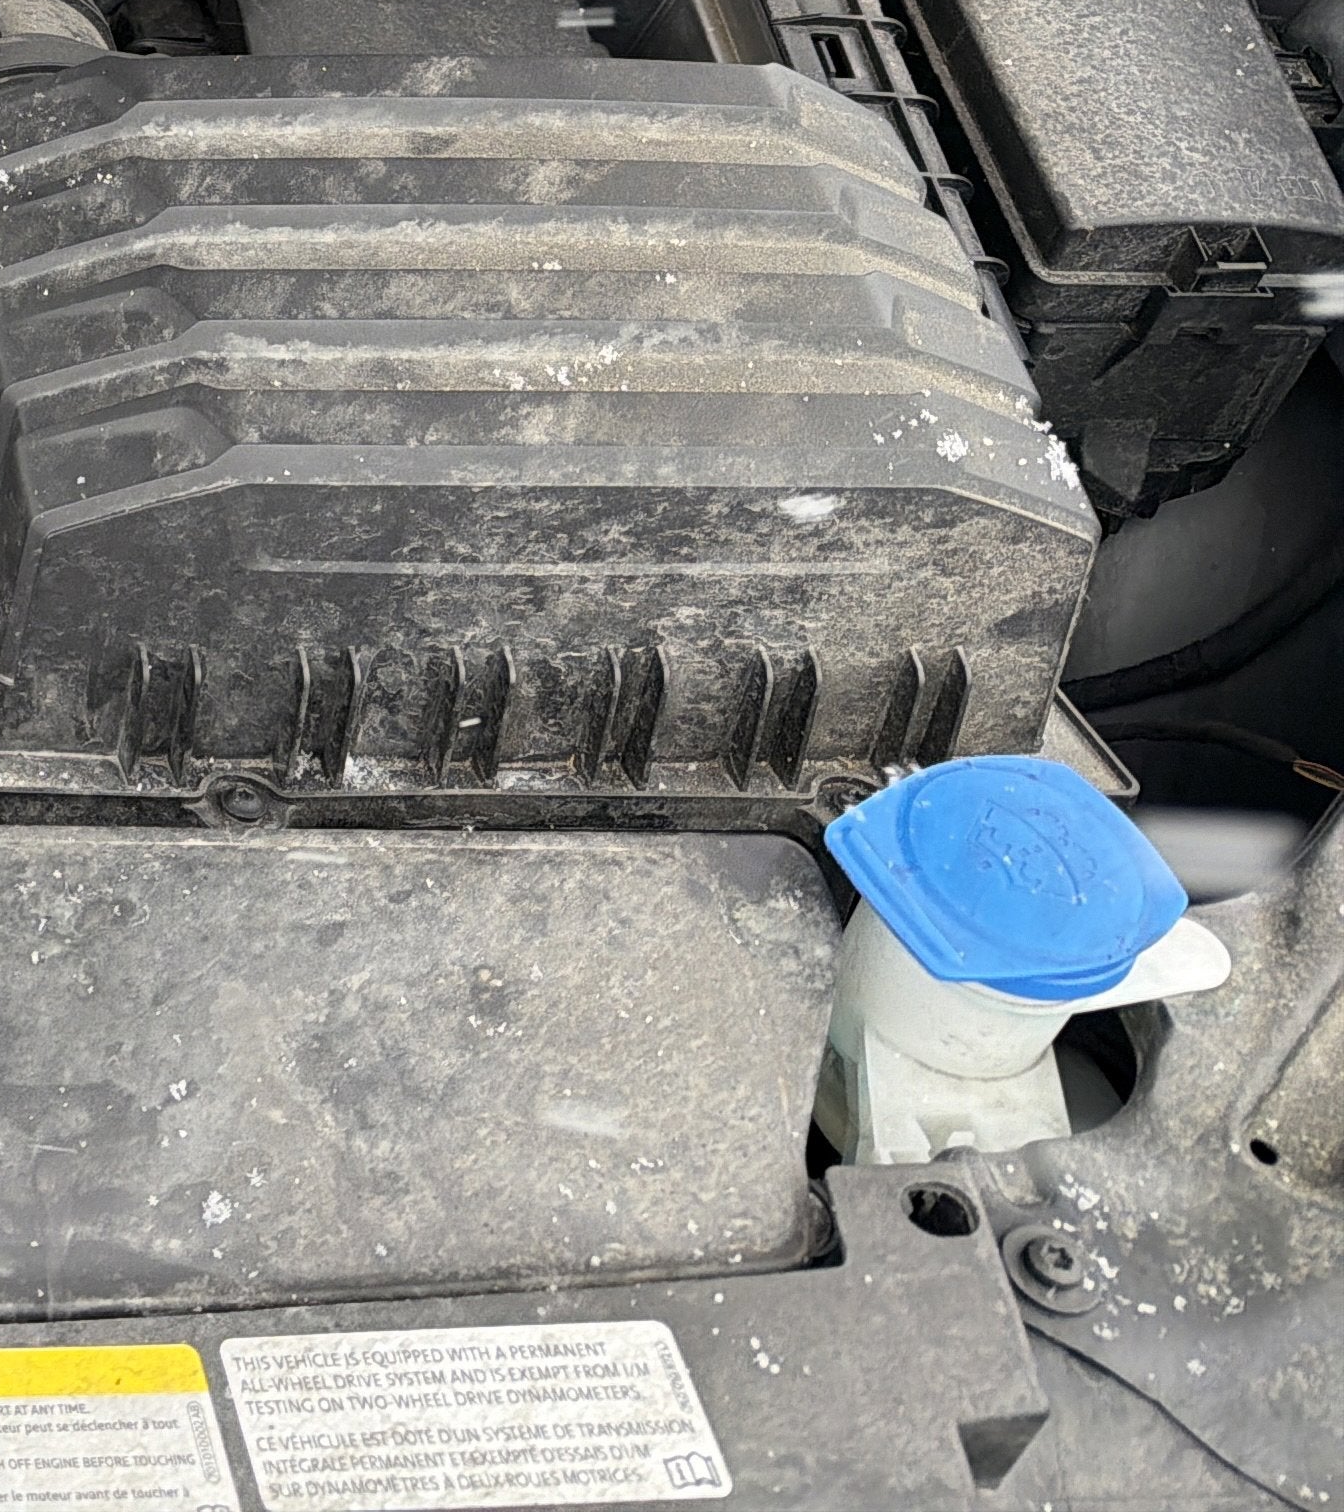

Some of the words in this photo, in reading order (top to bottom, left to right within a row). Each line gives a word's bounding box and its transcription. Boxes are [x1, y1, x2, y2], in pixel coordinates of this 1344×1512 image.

[233, 1355, 271, 1373] THIS
[273, 1352, 342, 1371] VEHICLE
[345, 1351, 361, 1369] IS
[363, 1348, 443, 1368] EQUIPPED
[446, 1346, 490, 1363] WITH
[495, 1346, 507, 1360] A
[512, 1342, 608, 1360] PERMANENT
[241, 1375, 333, 1394] ALL-WHEEL
[334, 1372, 382, 1390] DRIVE
[385, 1369, 446, 1387] SYSTEM
[450, 1368, 487, 1385] AND
[492, 1367, 505, 1382] IS
[508, 1365, 570, 1381] EXEMPT
[574, 1363, 620, 1379] FROM
[625, 1361, 651, 1377] I/M
[14, 1405, 28, 1416] AT
[31, 1404, 54, 1415] ANY
[246, 1397, 315, 1416] TESTING
[318, 1396, 345, 1413] ON
[347, 1392, 452, 1412] TWO-WHEEL
[455, 1389, 505, 1406] DRIVE
[24, 1422, 54, 1435] peut
[56, 1423, 70, 1432] se
[72, 1420, 139, 1433] déclencher
[152, 1418, 179, 1430] tout
[256, 1435, 278, 1452] CE
[362, 1431, 388, 1449] EST
[553, 1423, 577, 1440] DE
[579, 1418, 696, 1438] TRANSMISSION
[8, 1458, 32, 1470] OFF
[35, 1457, 80, 1469] ENGINE
[83, 1455, 130, 1468] BEFORE
[133, 1454, 196, 1467] TOUCHING
[351, 1452, 450, 1472] PERMANENT
[452, 1450, 468, 1468] ET
[12, 1490, 24, 1502] le
[26, 1490, 72, 1502] moteur
[75, 1490, 110, 1500] avant
[112, 1488, 129, 1499] de
[131, 1487, 179, 1498] toucher
[269, 1482, 303, 1499] SUR
[457, 1472, 504, 1490] DEUX
[506, 1469, 560, 1488] ROUES
